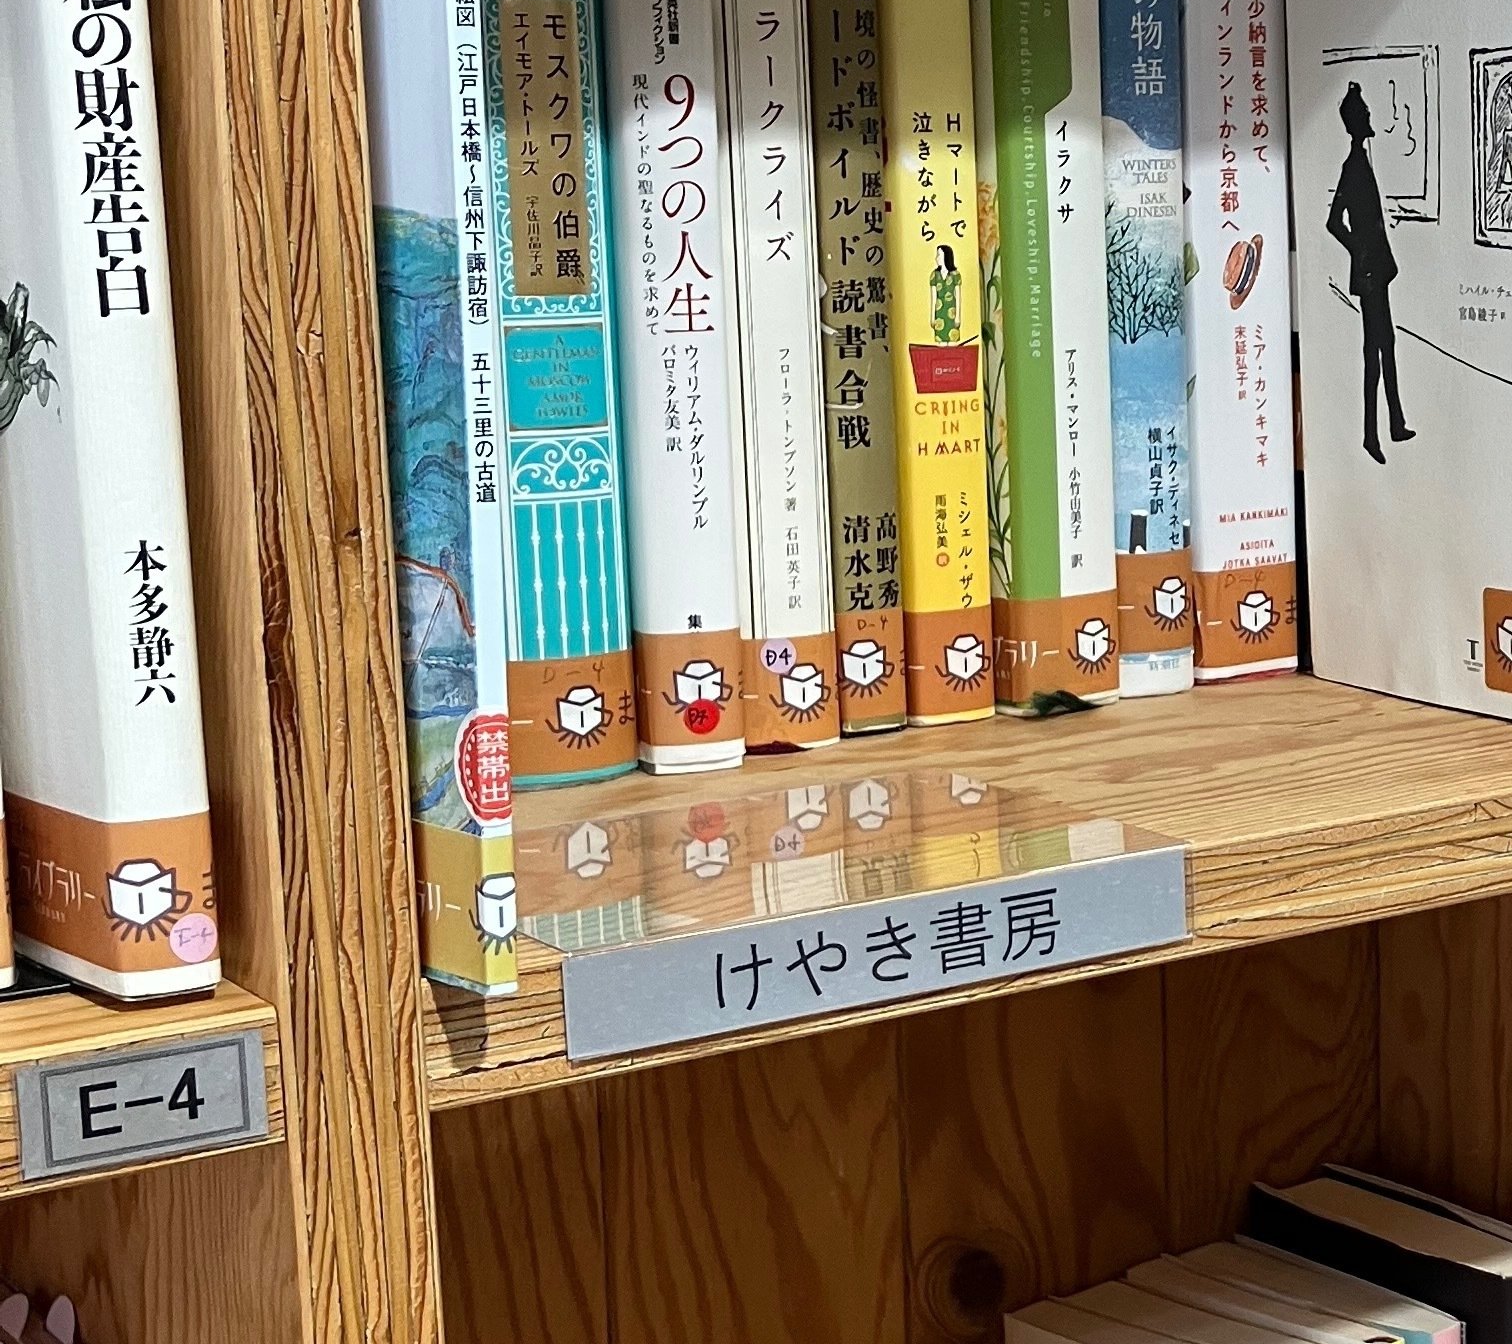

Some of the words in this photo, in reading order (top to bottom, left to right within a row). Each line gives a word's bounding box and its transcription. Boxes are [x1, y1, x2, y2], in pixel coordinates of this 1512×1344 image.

[513, 12, 540, 177] エイモア・トールズ
[542, 13, 583, 280] モスクワの伯爵
[755, 10, 795, 263] ラークライズ
[631, 73, 660, 337] 現代インドの聖なるものを求めて
[657, 73, 715, 336] 9つの人生
[912, 111, 937, 243] 泣きながら
[946, 112, 968, 239] Hマートで
[1055, 120, 1075, 224] イラクサ
[1127, 205, 1177, 218] DINESEN
[1132, 171, 1169, 184] TALES
[1140, 192, 1168, 205] ISAK
[471, 352, 497, 503] 五十三里の古道
[683, 343, 709, 530] ウィリアム・ダルリンプル
[778, 347, 797, 494] フローラ・トンプソン
[914, 398, 980, 417] CRYING
[918, 442, 928, 456] H
[934, 438, 981, 457] MART
[942, 419, 960, 435] IN
[1065, 348, 1078, 457] アリス・マンロー
[1253, 323, 1269, 468] ミア・カンキマキ
[1147, 427, 1164, 515] 横山貞子訳
[1166, 426, 1181, 551] イサク・ディネセ
[124, 539, 177, 708] 本多静六
[477, 730, 510, 804] 禁帯出
[714, 887, 1063, 1012] けやき書房
[78, 1067, 206, 1141] E-4
